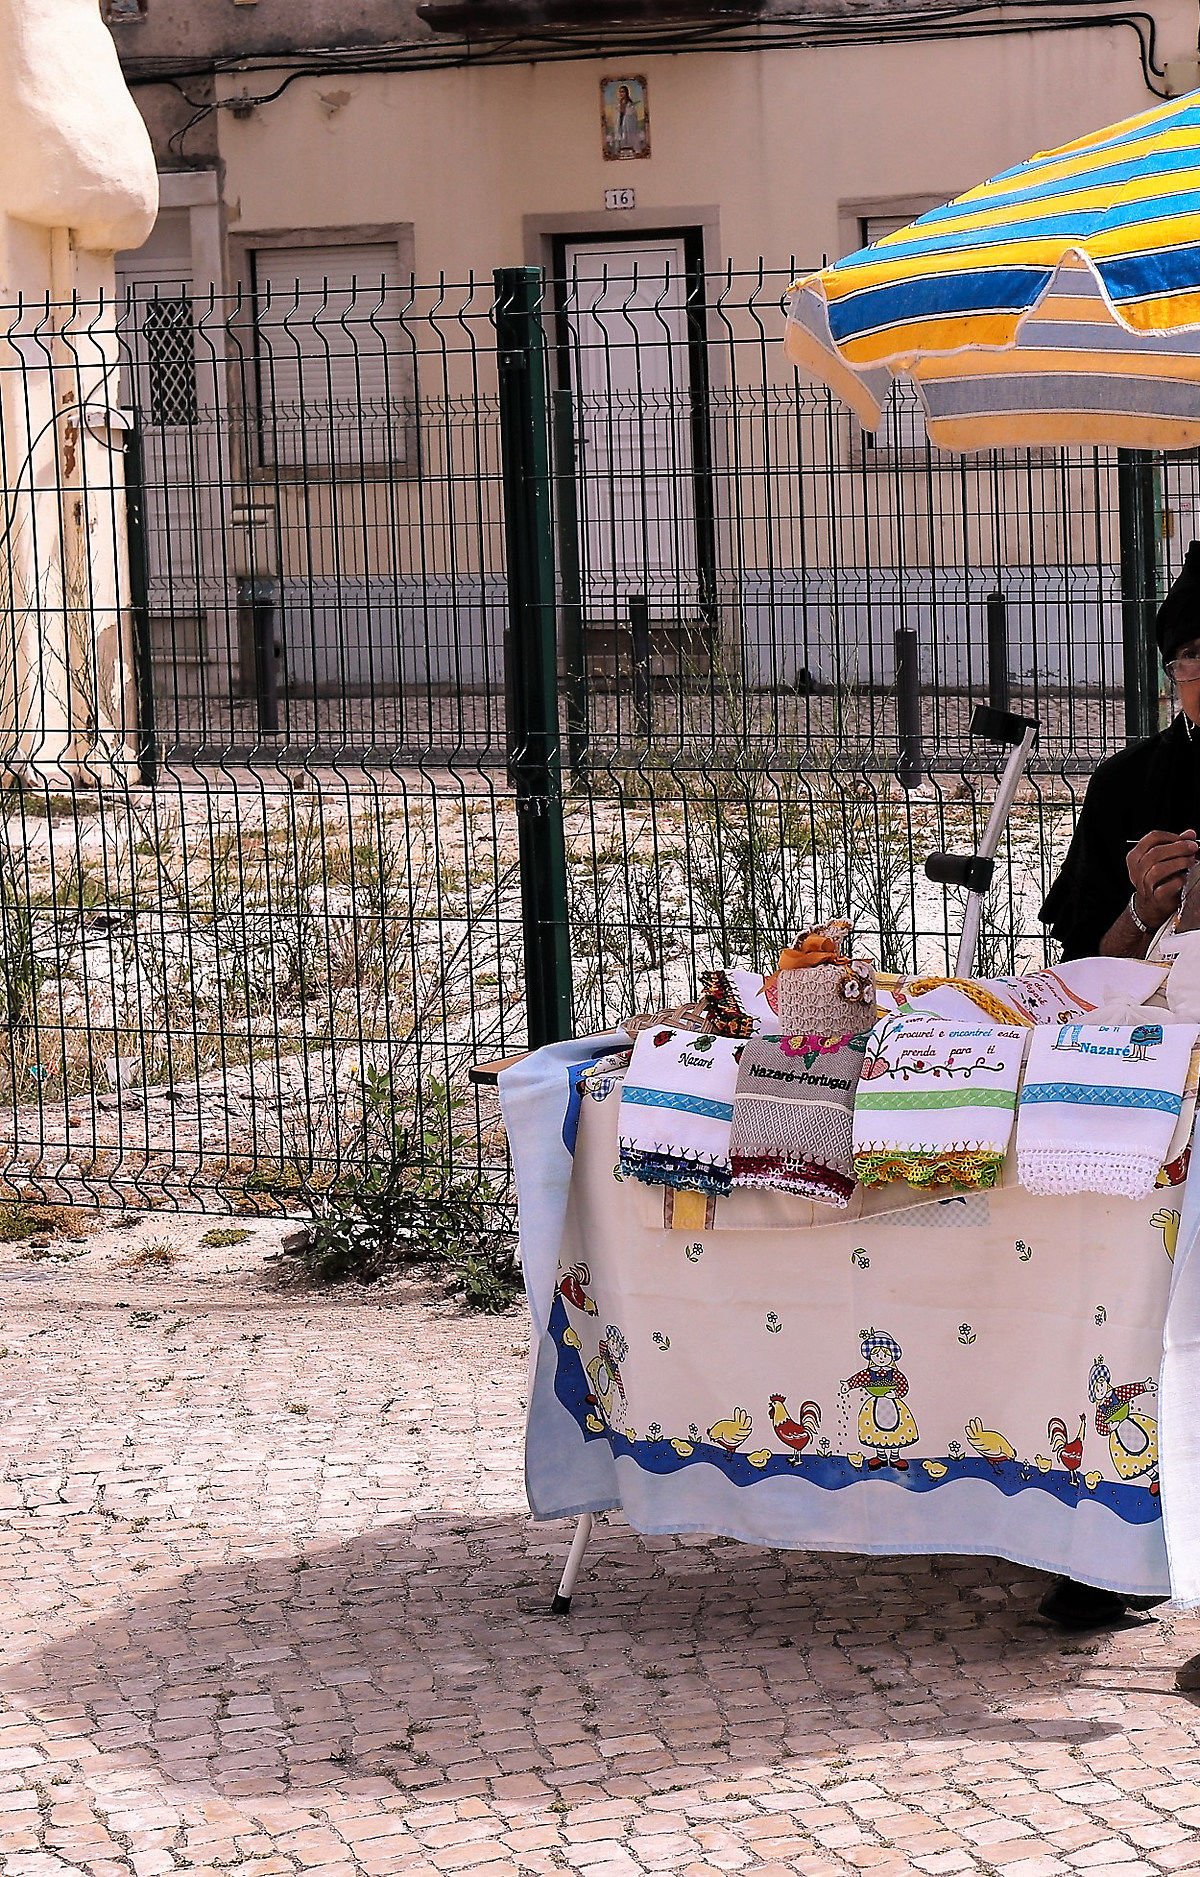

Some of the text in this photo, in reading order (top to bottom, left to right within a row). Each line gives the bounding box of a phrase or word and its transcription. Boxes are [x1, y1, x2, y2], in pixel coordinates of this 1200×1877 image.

[612, 191, 628, 205] 16
[900, 1045, 936, 1059] prenda
[949, 1047, 972, 1058] para
[1080, 1042, 1131, 1057] Nazaré
[678, 1052, 715, 1068] Nazaré
[749, 1064, 852, 1091] Nazaré-Portugal
